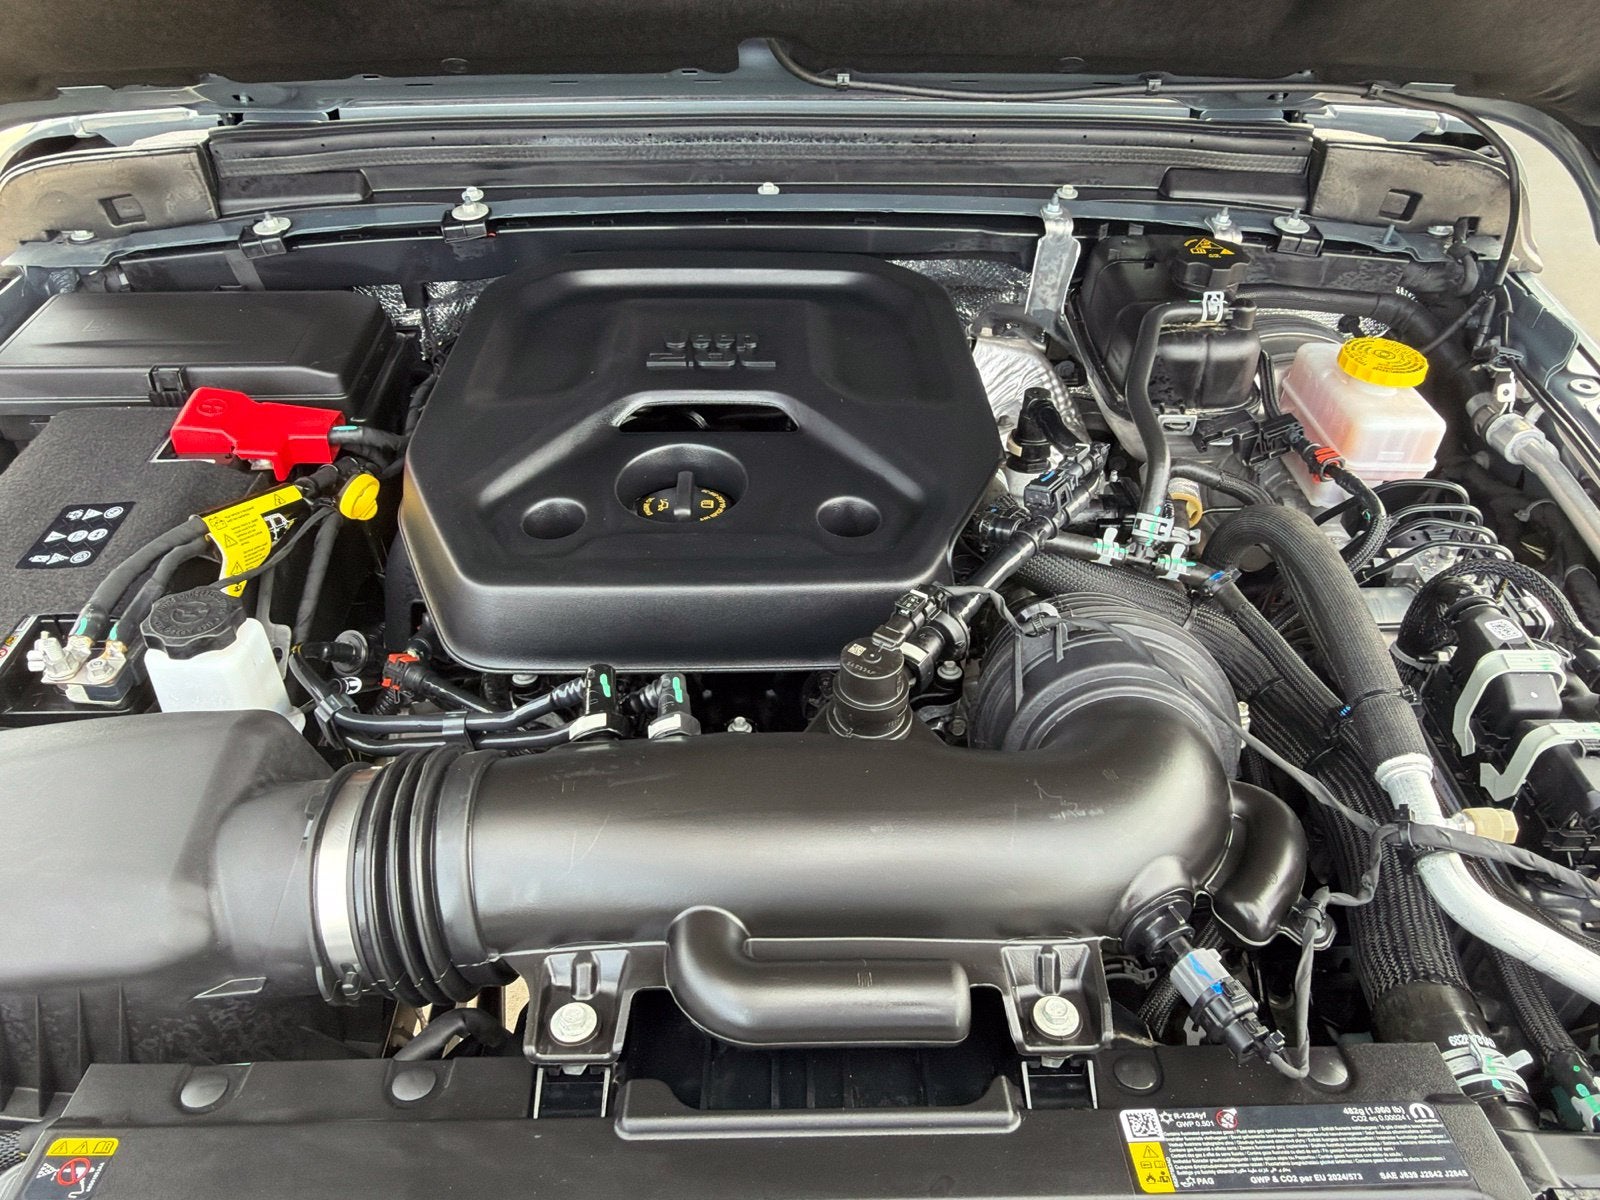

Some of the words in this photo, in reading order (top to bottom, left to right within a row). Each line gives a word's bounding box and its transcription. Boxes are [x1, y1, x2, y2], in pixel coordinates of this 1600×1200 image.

[1173, 1111, 1207, 1120] R-1234yf
[1176, 1120, 1194, 1128] GWP
[1195, 1119, 1215, 1127] 0.501
[1250, 1176, 1270, 1184] GWP
[1272, 1175, 1279, 1183] &
[1280, 1174, 1299, 1183] CO2
[1300, 1175, 1313, 1183] per
[1315, 1173, 1327, 1181] EU
[1379, 1171, 1398, 1180] SAE
[1196, 1177, 1215, 1185] PAG
